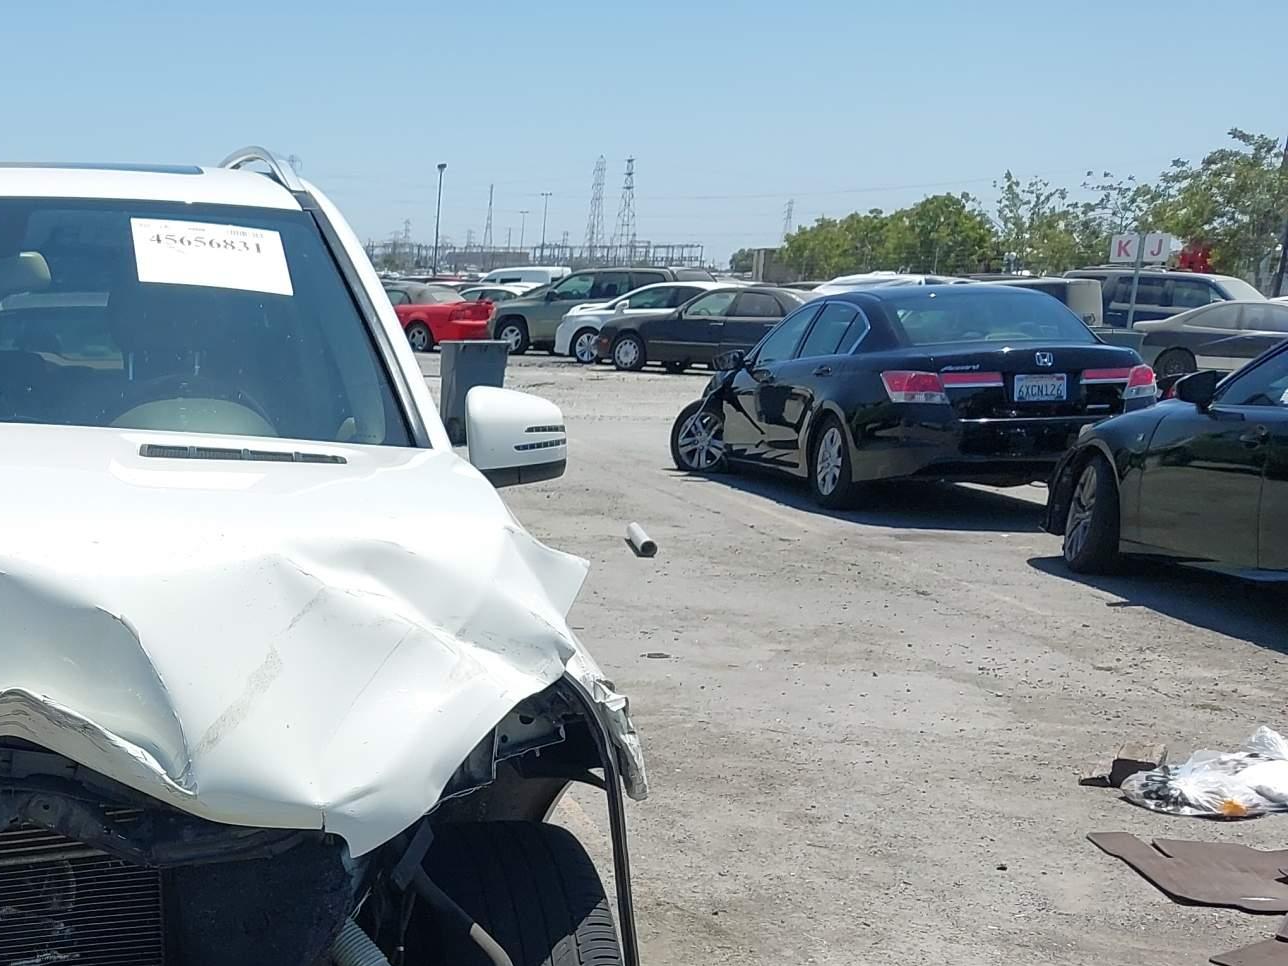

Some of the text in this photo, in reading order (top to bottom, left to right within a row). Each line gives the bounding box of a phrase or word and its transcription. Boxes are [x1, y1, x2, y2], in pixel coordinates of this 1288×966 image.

[150, 233, 261, 254] 45656831
[1117, 240, 1131, 257] K
[1150, 239, 1163, 256] J
[1018, 384, 1062, 397] 6XCN126
